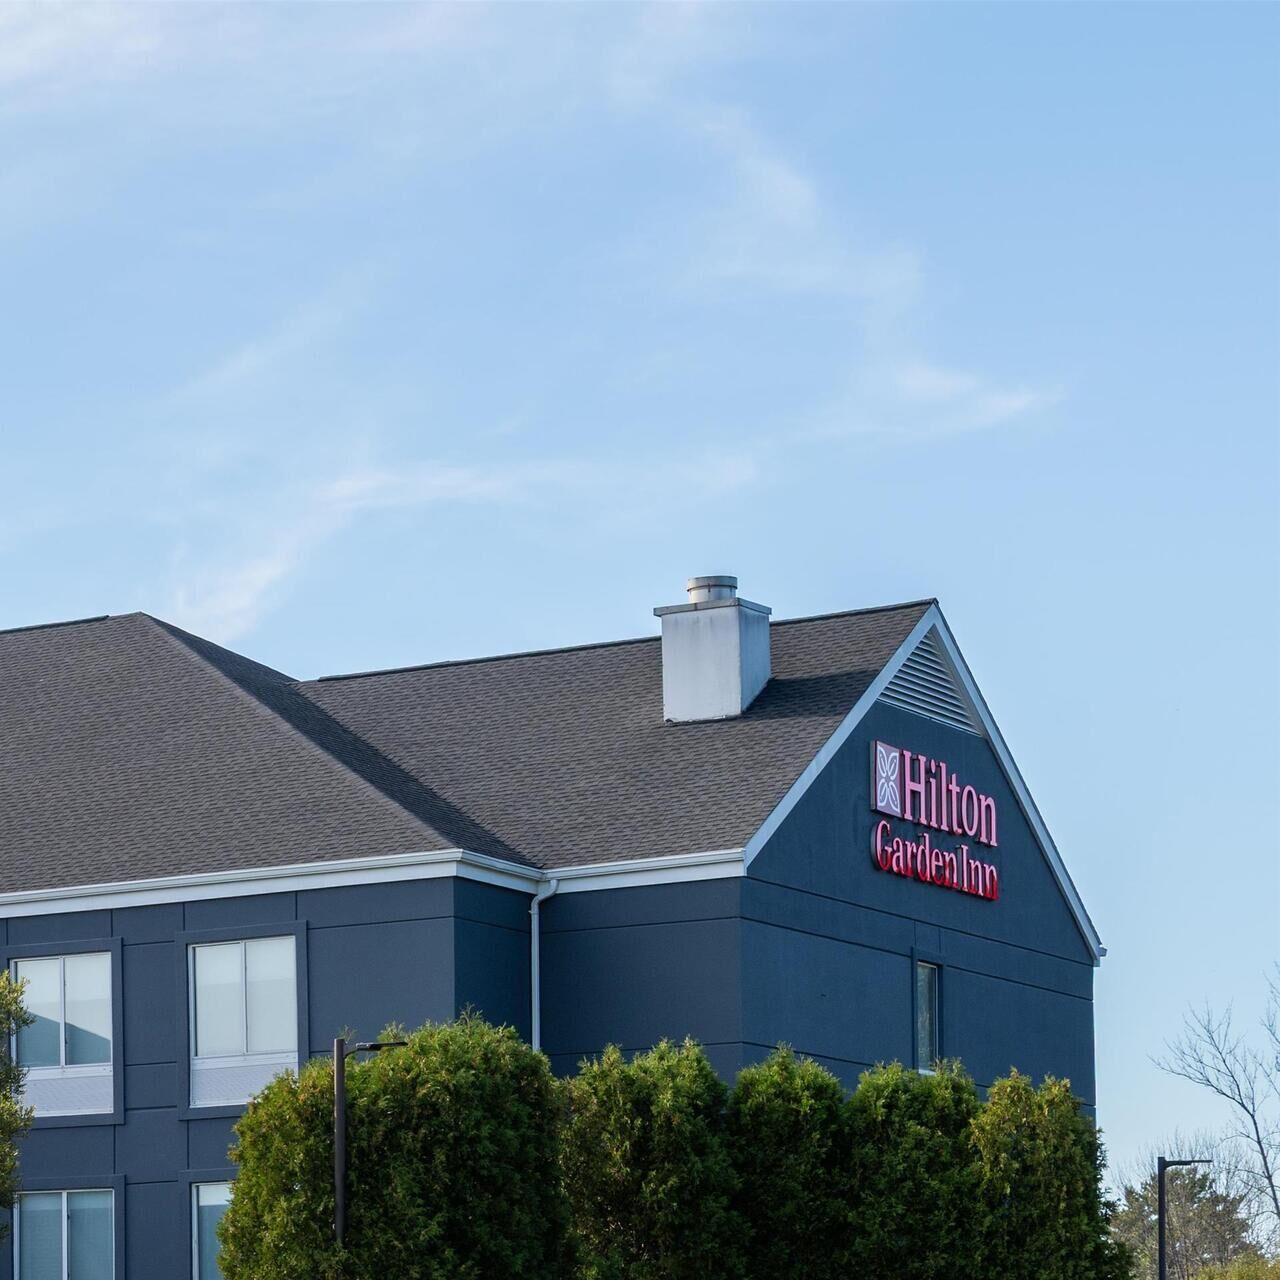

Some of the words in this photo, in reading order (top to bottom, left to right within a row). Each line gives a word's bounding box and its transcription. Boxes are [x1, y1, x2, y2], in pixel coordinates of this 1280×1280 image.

[901, 749, 998, 847] Hilton
[874, 819, 959, 889] Garden
[959, 844, 1000, 901] Inn
